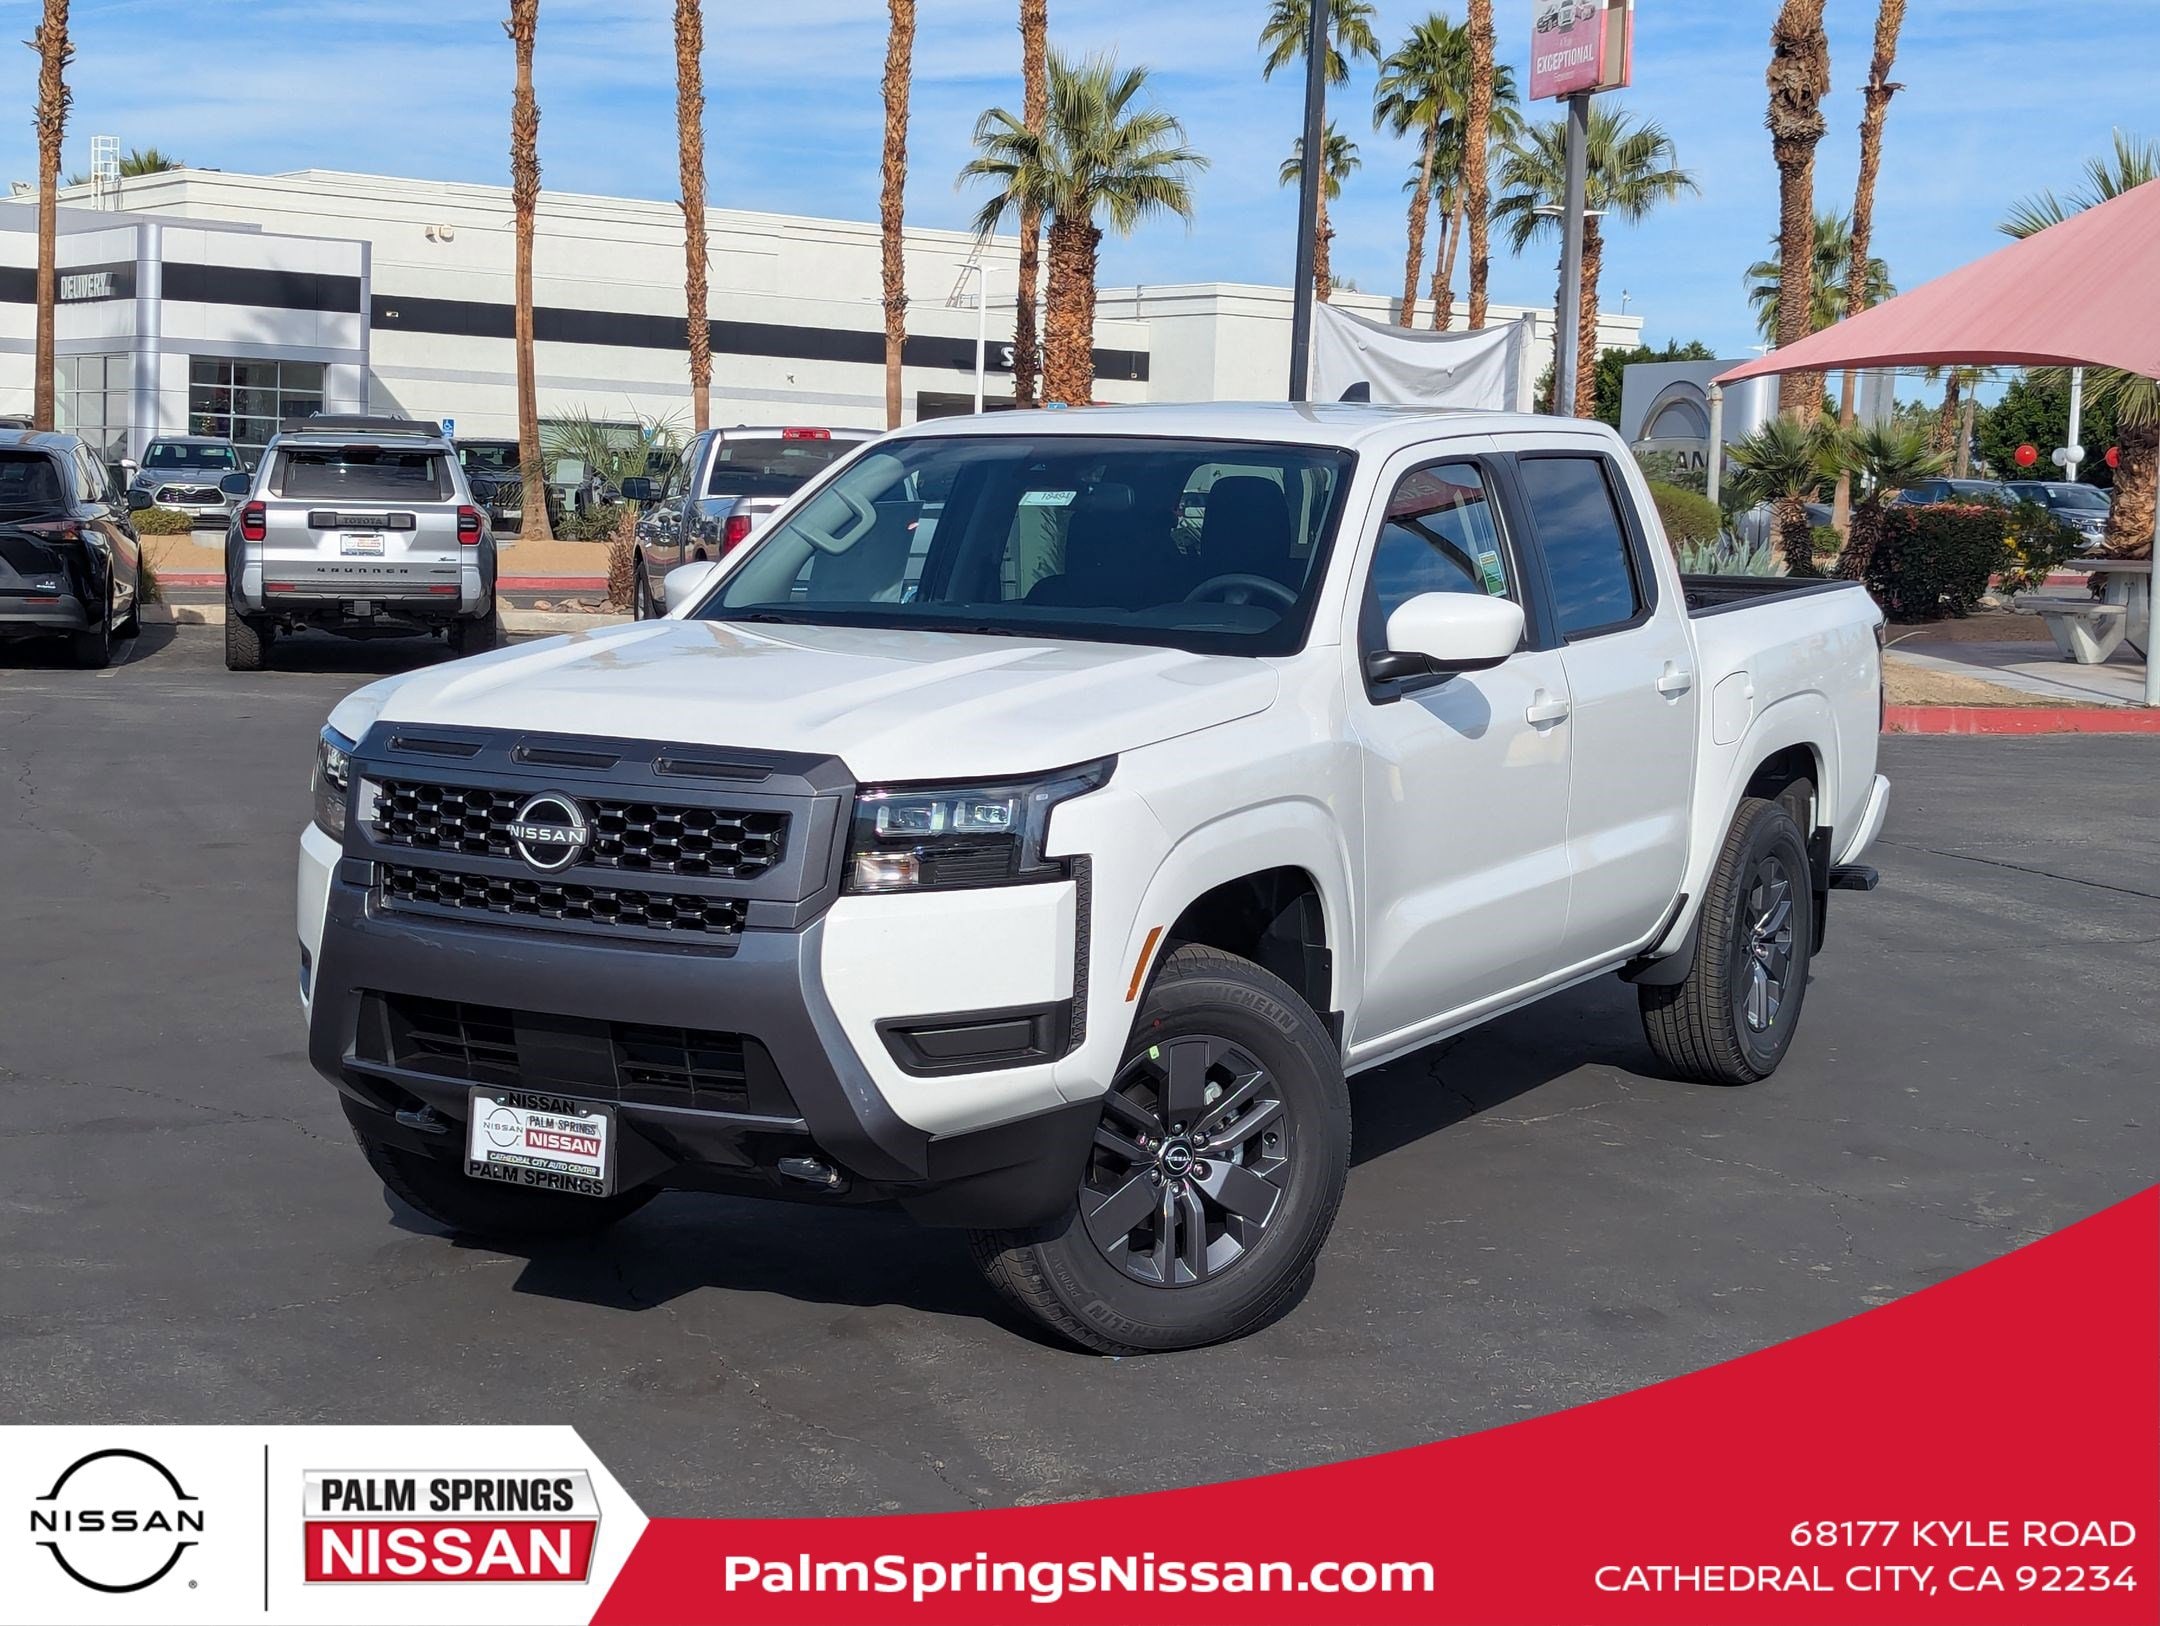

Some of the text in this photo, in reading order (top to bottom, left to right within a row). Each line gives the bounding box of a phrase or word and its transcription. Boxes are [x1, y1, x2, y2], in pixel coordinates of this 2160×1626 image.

[1537, 44, 1594, 74] EXCEPTIONAL
[61, 272, 109, 299] DELIVERY
[343, 516, 383, 526] TOYOTA
[509, 824, 584, 843] NISSAN
[1204, 985, 1297, 1031] MICHELIN
[508, 1092, 575, 1115] NISSAN
[483, 1121, 524, 1134] NISSAN
[529, 1115, 596, 1136] PALM SPRINGS
[529, 1132, 597, 1154] NISSAN
[490, 1152, 597, 1176] CATHEDRAL CITY AUTO CENTER
[469, 1161, 604, 1196] PALM SPRINGS
